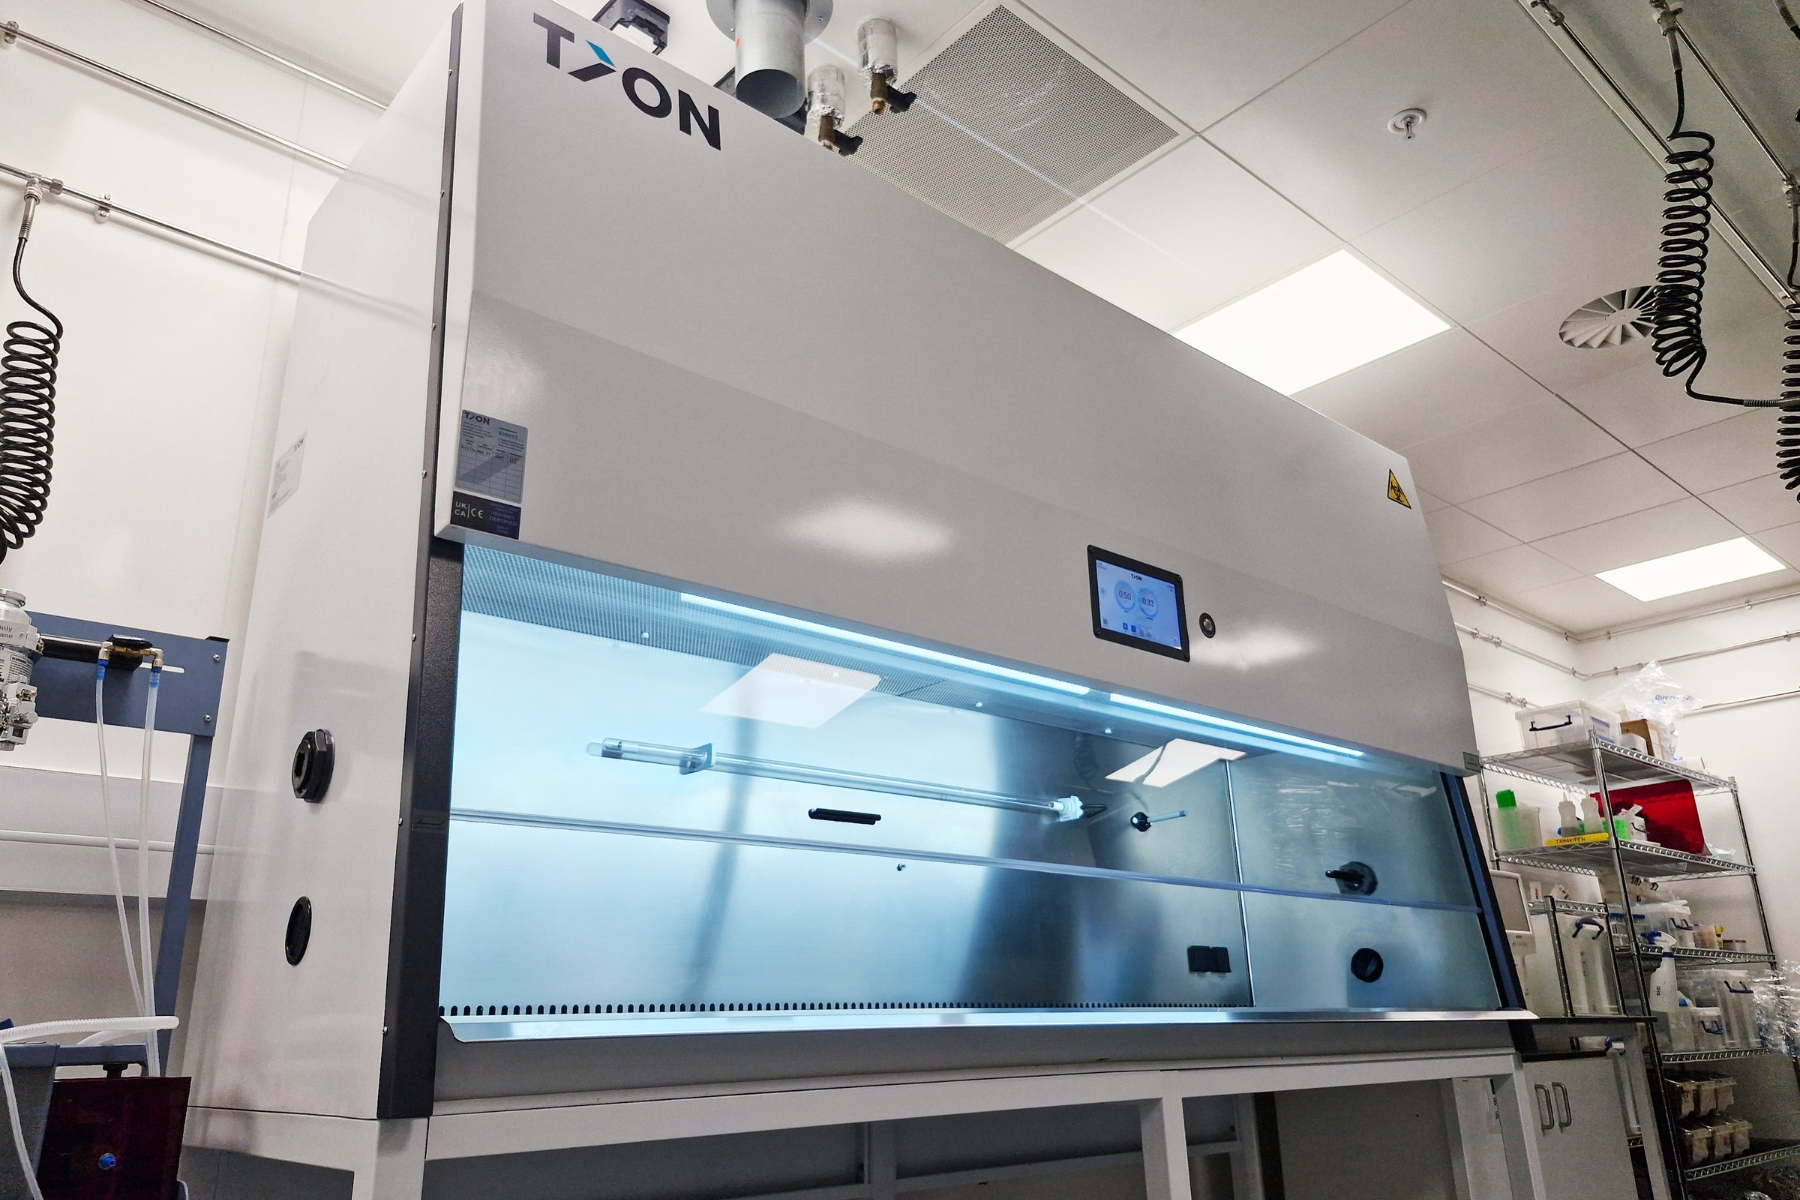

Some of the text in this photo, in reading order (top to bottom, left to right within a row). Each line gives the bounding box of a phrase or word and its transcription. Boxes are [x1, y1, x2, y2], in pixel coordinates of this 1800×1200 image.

[455, 501, 468, 509] UK
[454, 509, 467, 517] CA
[471, 508, 484, 518] CE
[1118, 590, 1132, 600] 0.50
